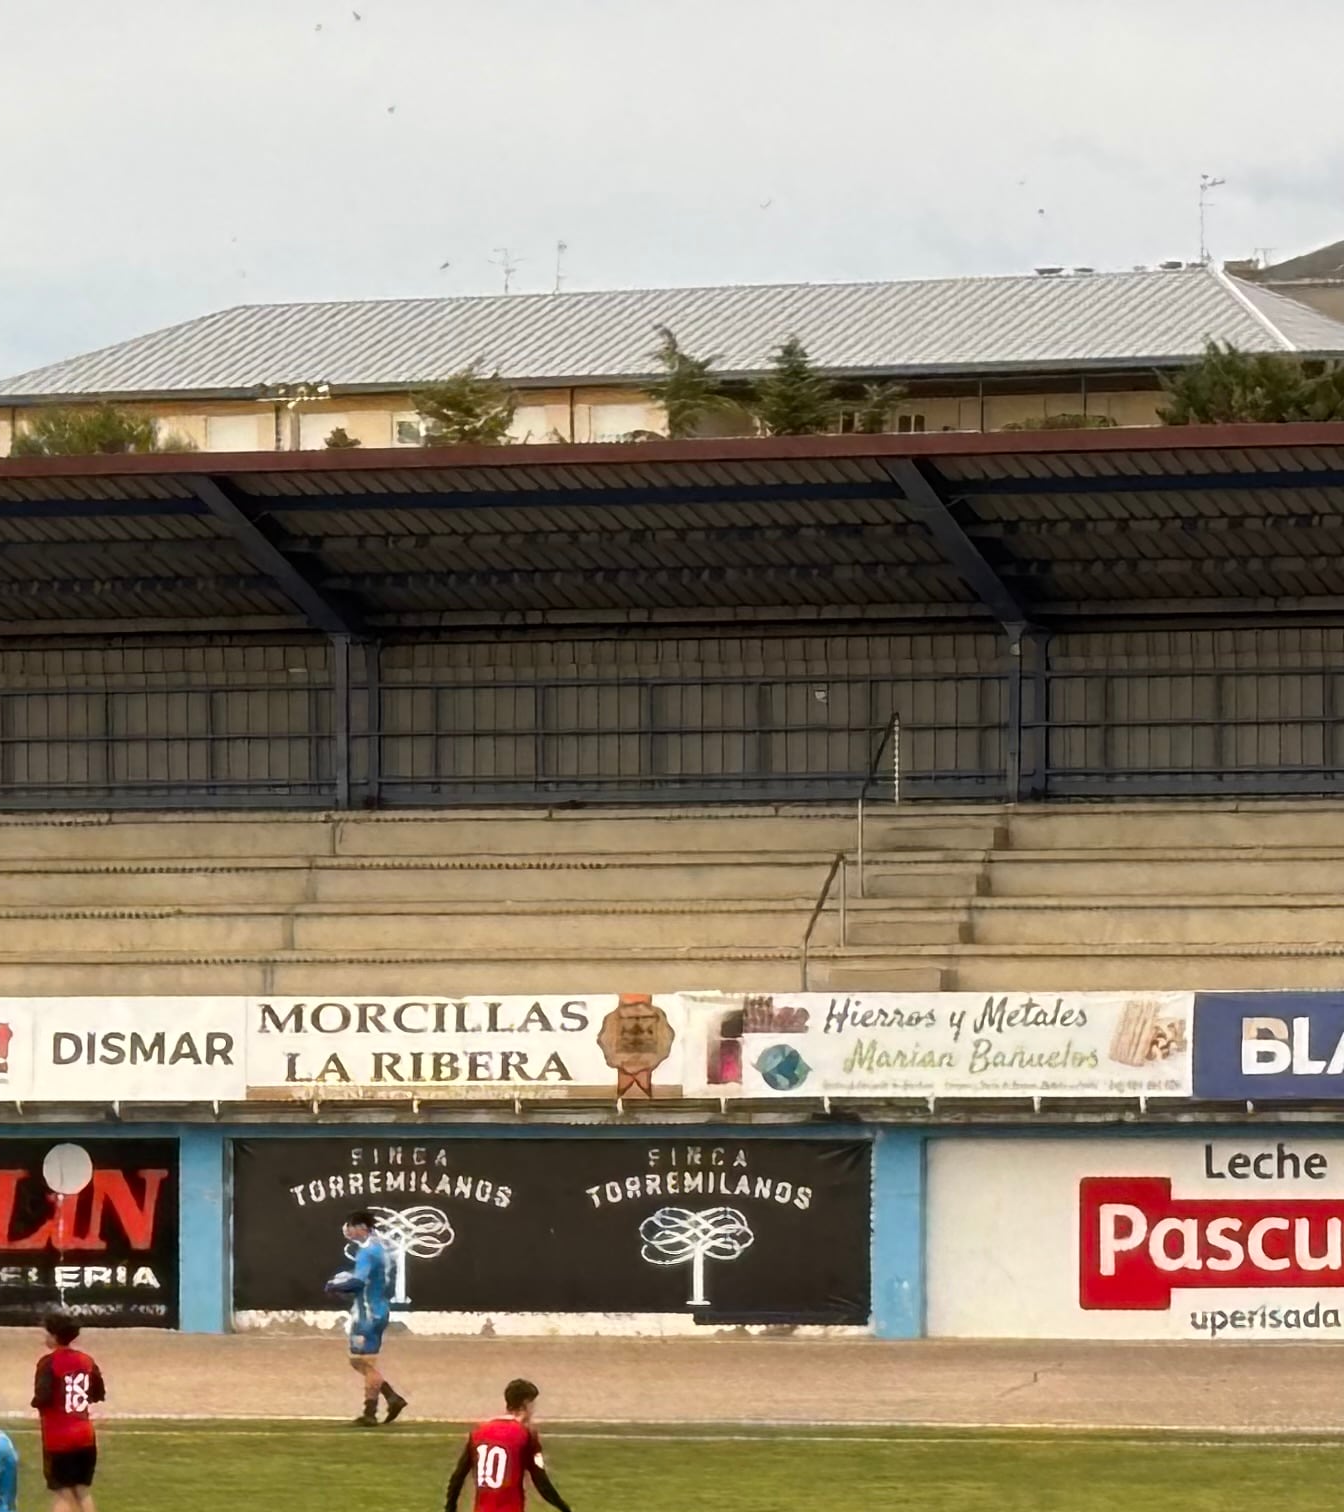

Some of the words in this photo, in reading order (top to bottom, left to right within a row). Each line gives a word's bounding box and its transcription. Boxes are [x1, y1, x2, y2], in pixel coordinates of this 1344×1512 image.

[257, 1001, 589, 1034] MORCILLAS
[823, 997, 937, 1034] Hierros
[948, 1010, 967, 1041] y
[973, 996, 1088, 1034] Metales
[52, 1031, 235, 1066] DISMAR
[284, 1051, 352, 1083] LA
[370, 1051, 574, 1083] RIBERA
[351, 1146, 448, 1167] FINCA
[648, 1146, 748, 1168] FINCA
[1204, 1143, 1328, 1180] Leche
[289, 1170, 513, 1208] TORREMILANOS
[585, 1170, 813, 1210] TORREMILANOS
[1190, 1302, 1341, 1336] uperisada
[64, 1373, 90, 1413] 18
[476, 1443, 508, 1489] 10
